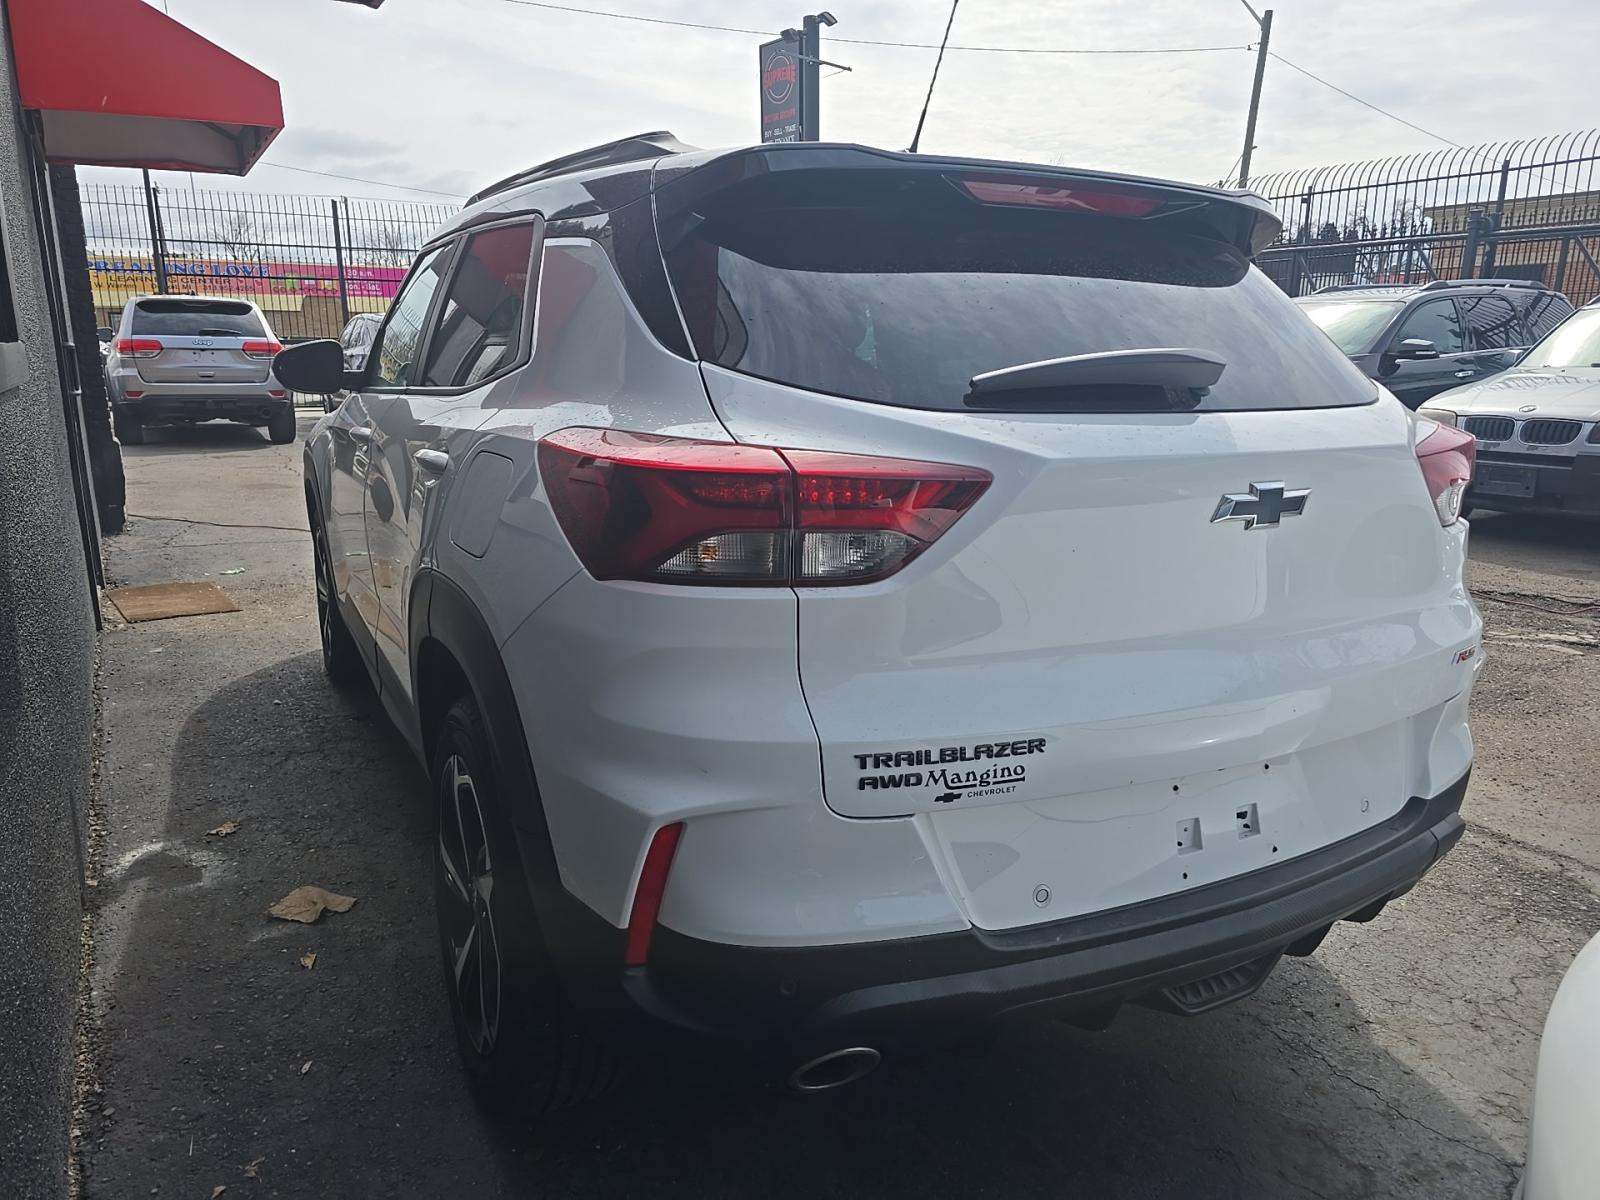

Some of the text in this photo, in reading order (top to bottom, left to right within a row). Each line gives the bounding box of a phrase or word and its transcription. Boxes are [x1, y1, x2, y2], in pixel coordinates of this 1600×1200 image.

[212, 263, 270, 277] LOVE
[192, 337, 214, 346] Jeep
[854, 737, 1047, 770] TRAILBLAZER
[859, 772, 922, 791] AWD
[924, 763, 1026, 790] Mangino
[967, 785, 1017, 799] CHEVROLET
